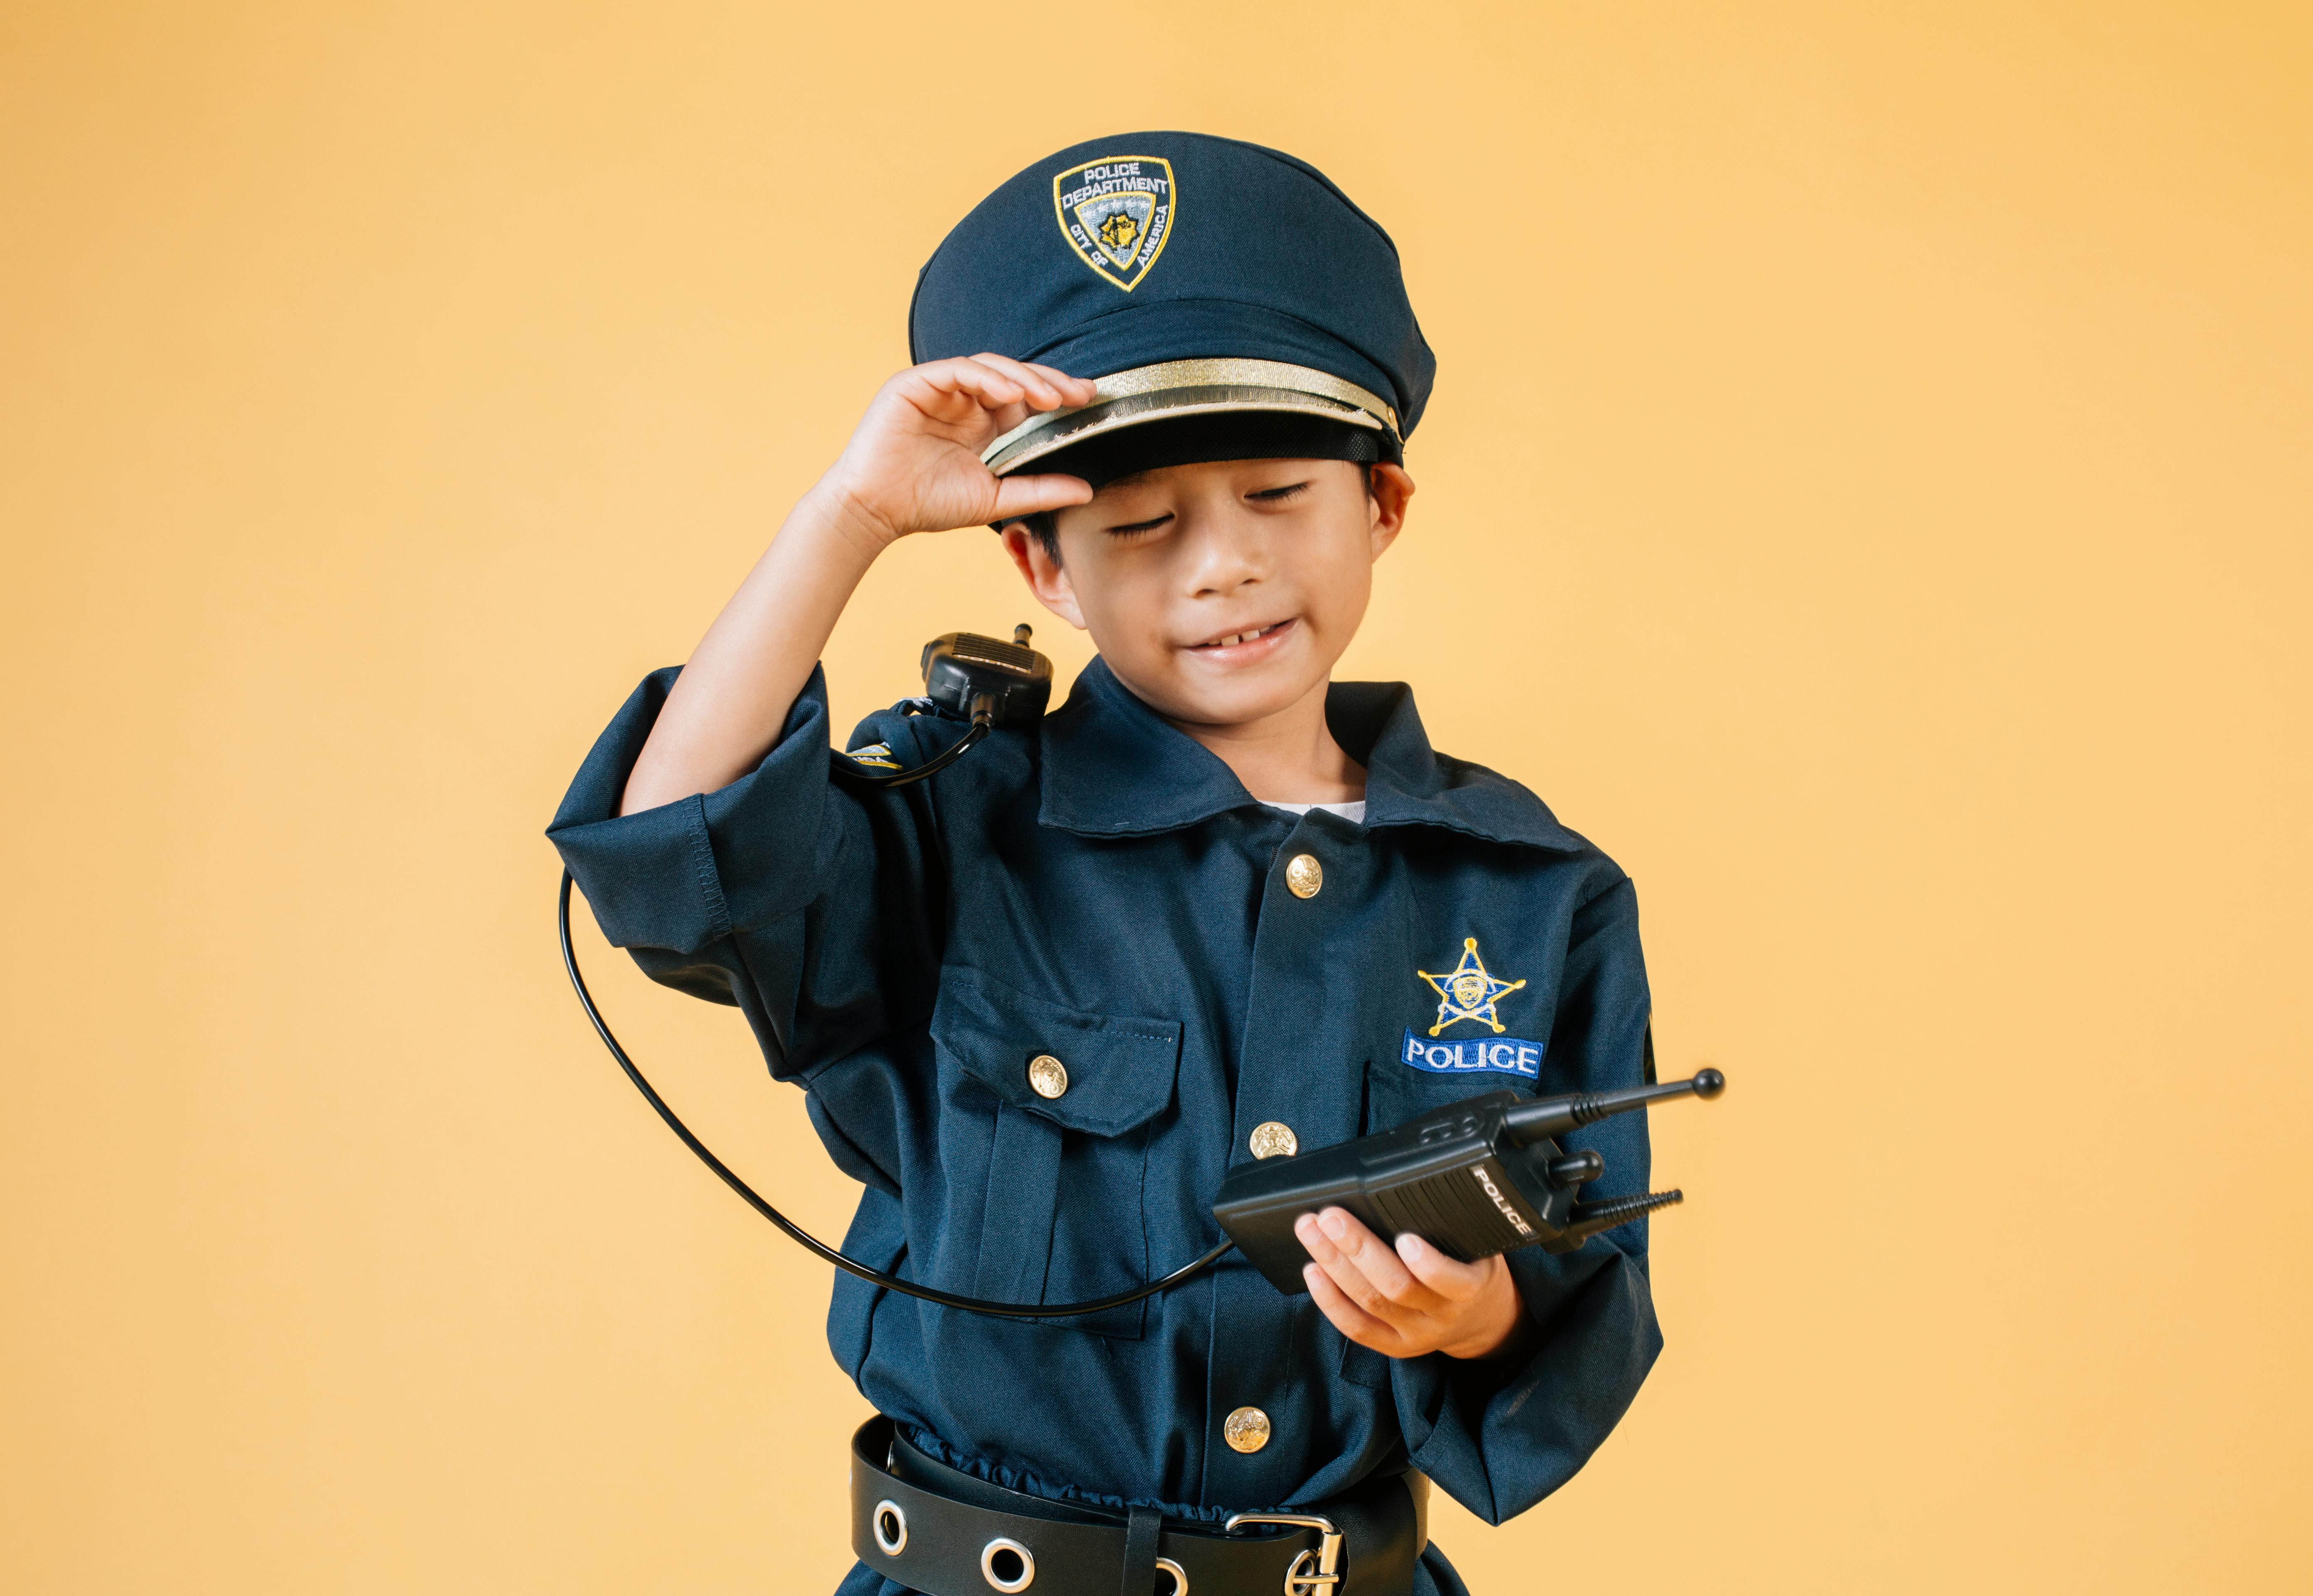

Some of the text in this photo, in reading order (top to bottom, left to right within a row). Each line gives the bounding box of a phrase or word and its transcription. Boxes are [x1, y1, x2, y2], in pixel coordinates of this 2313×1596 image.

[1084, 163, 1140, 184] POLICE
[1062, 177, 1167, 210] DEPARTMENT
[1070, 224, 1109, 266] CITY OF
[1137, 205, 1168, 267] AMERICA
[1407, 1038, 1539, 1074] POLICE
[1473, 1168, 1532, 1235] POLICE
